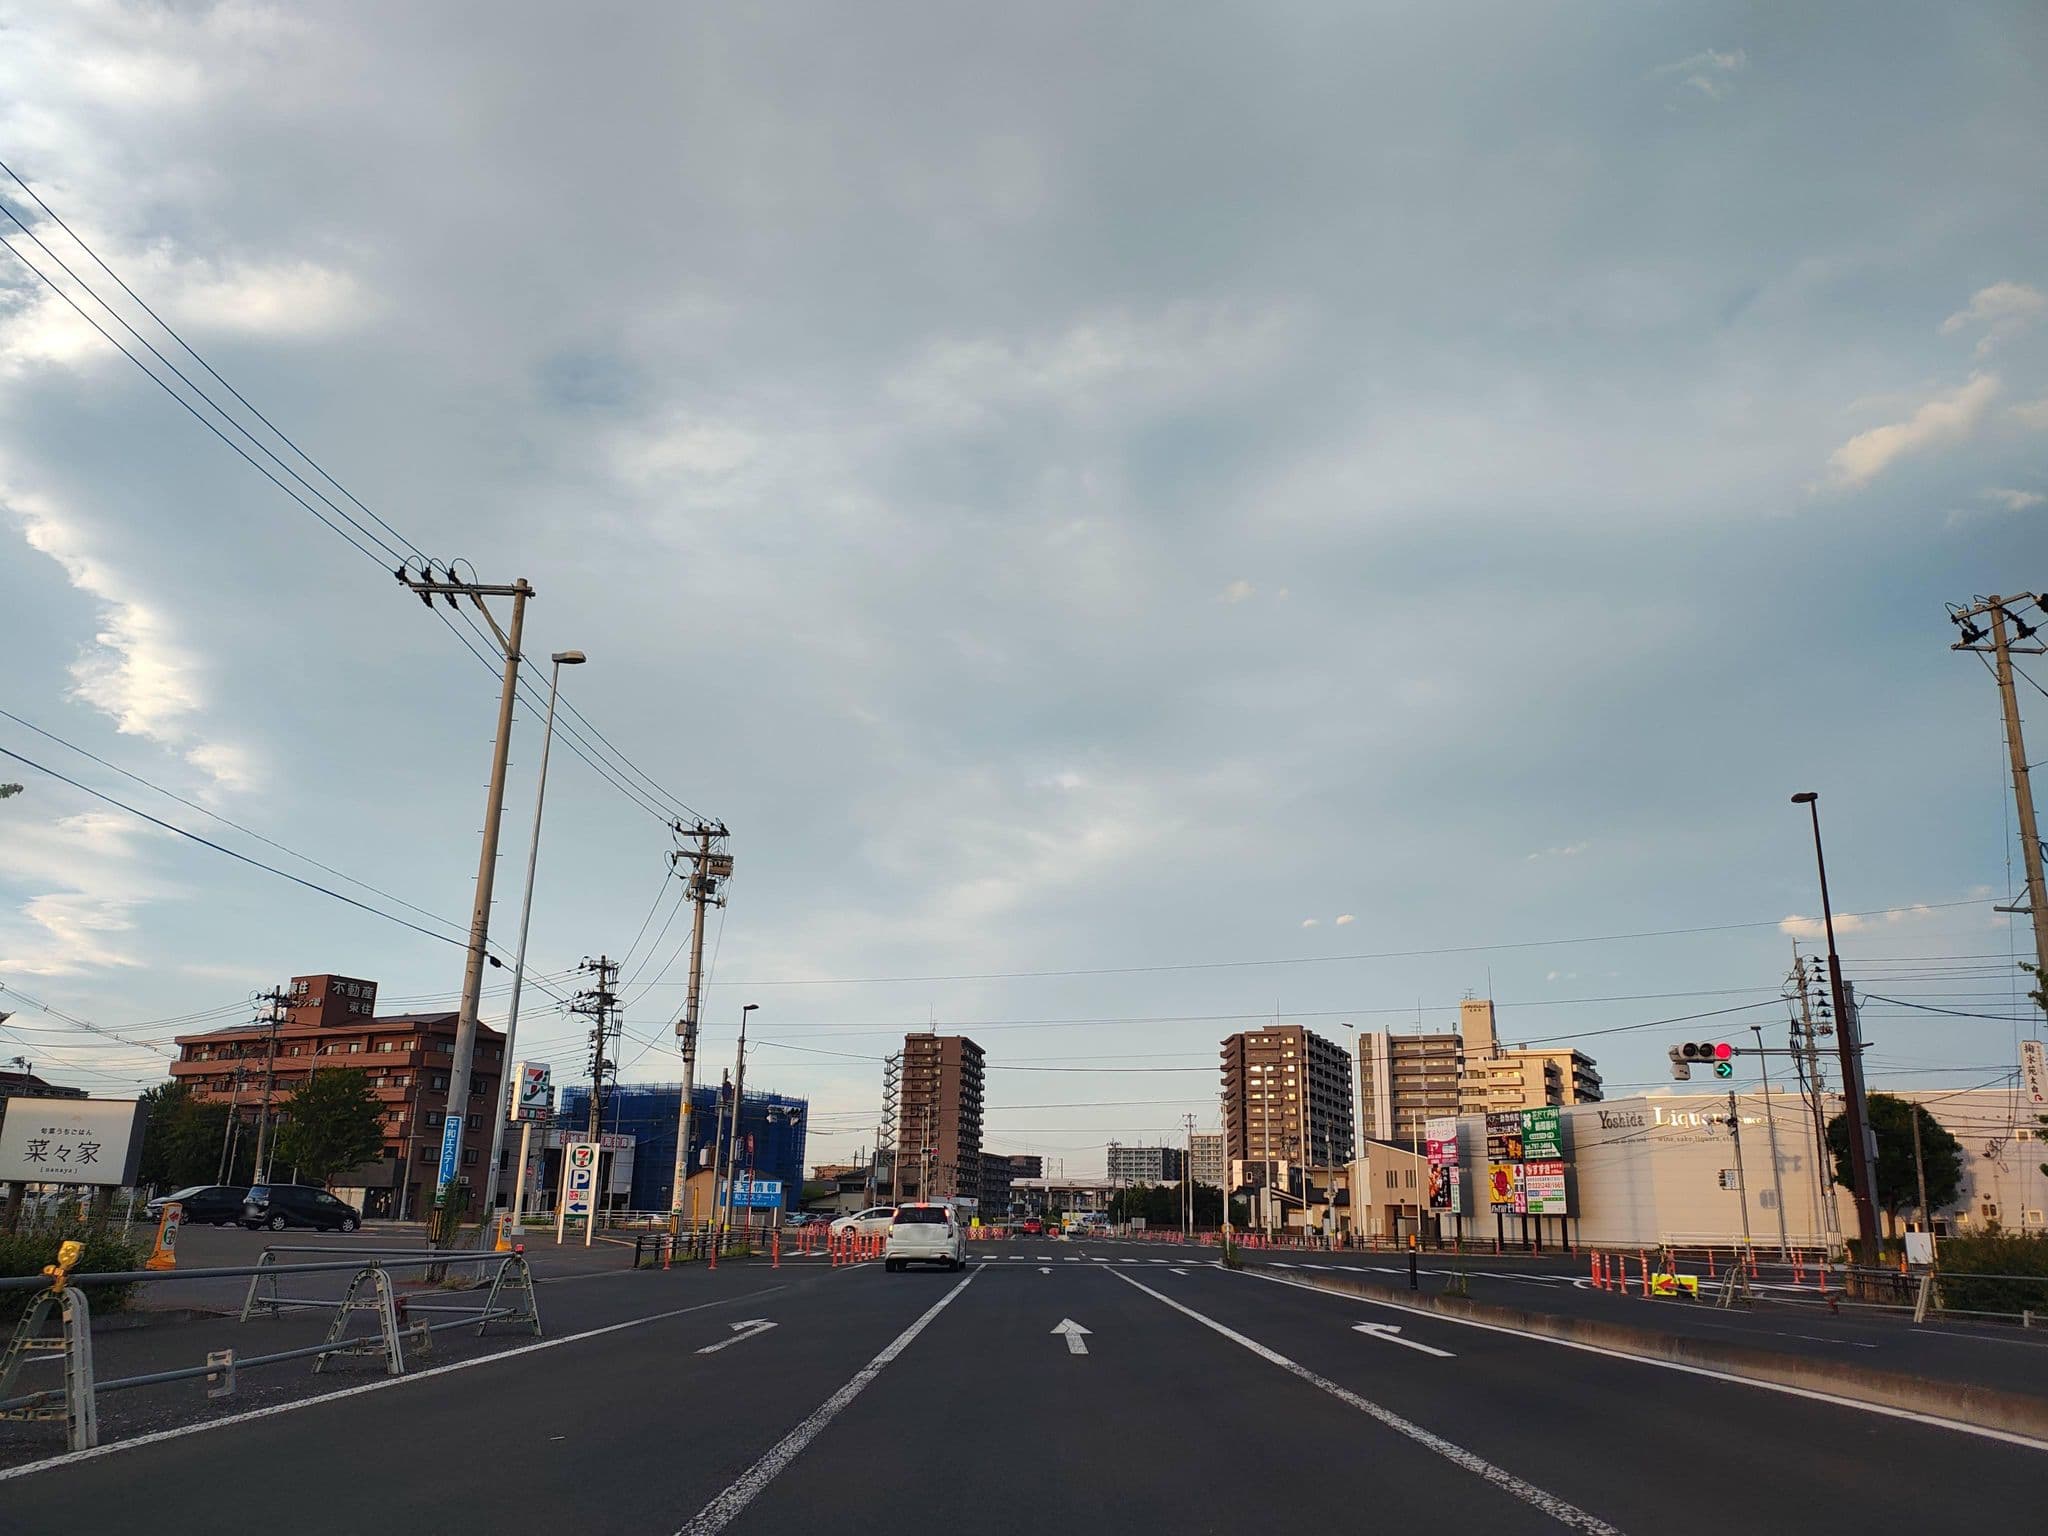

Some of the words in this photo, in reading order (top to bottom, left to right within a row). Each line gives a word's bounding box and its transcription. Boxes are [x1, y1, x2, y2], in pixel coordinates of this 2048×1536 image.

[332, 981, 374, 999] 不動産
[349, 1002, 373, 1014] 東住
[1597, 1110, 1645, 1129] Yoshida
[23, 1138, 101, 1164] 菜々家
[443, 1119, 458, 1180] 平和エステート
[573, 1171, 590, 1189] P
